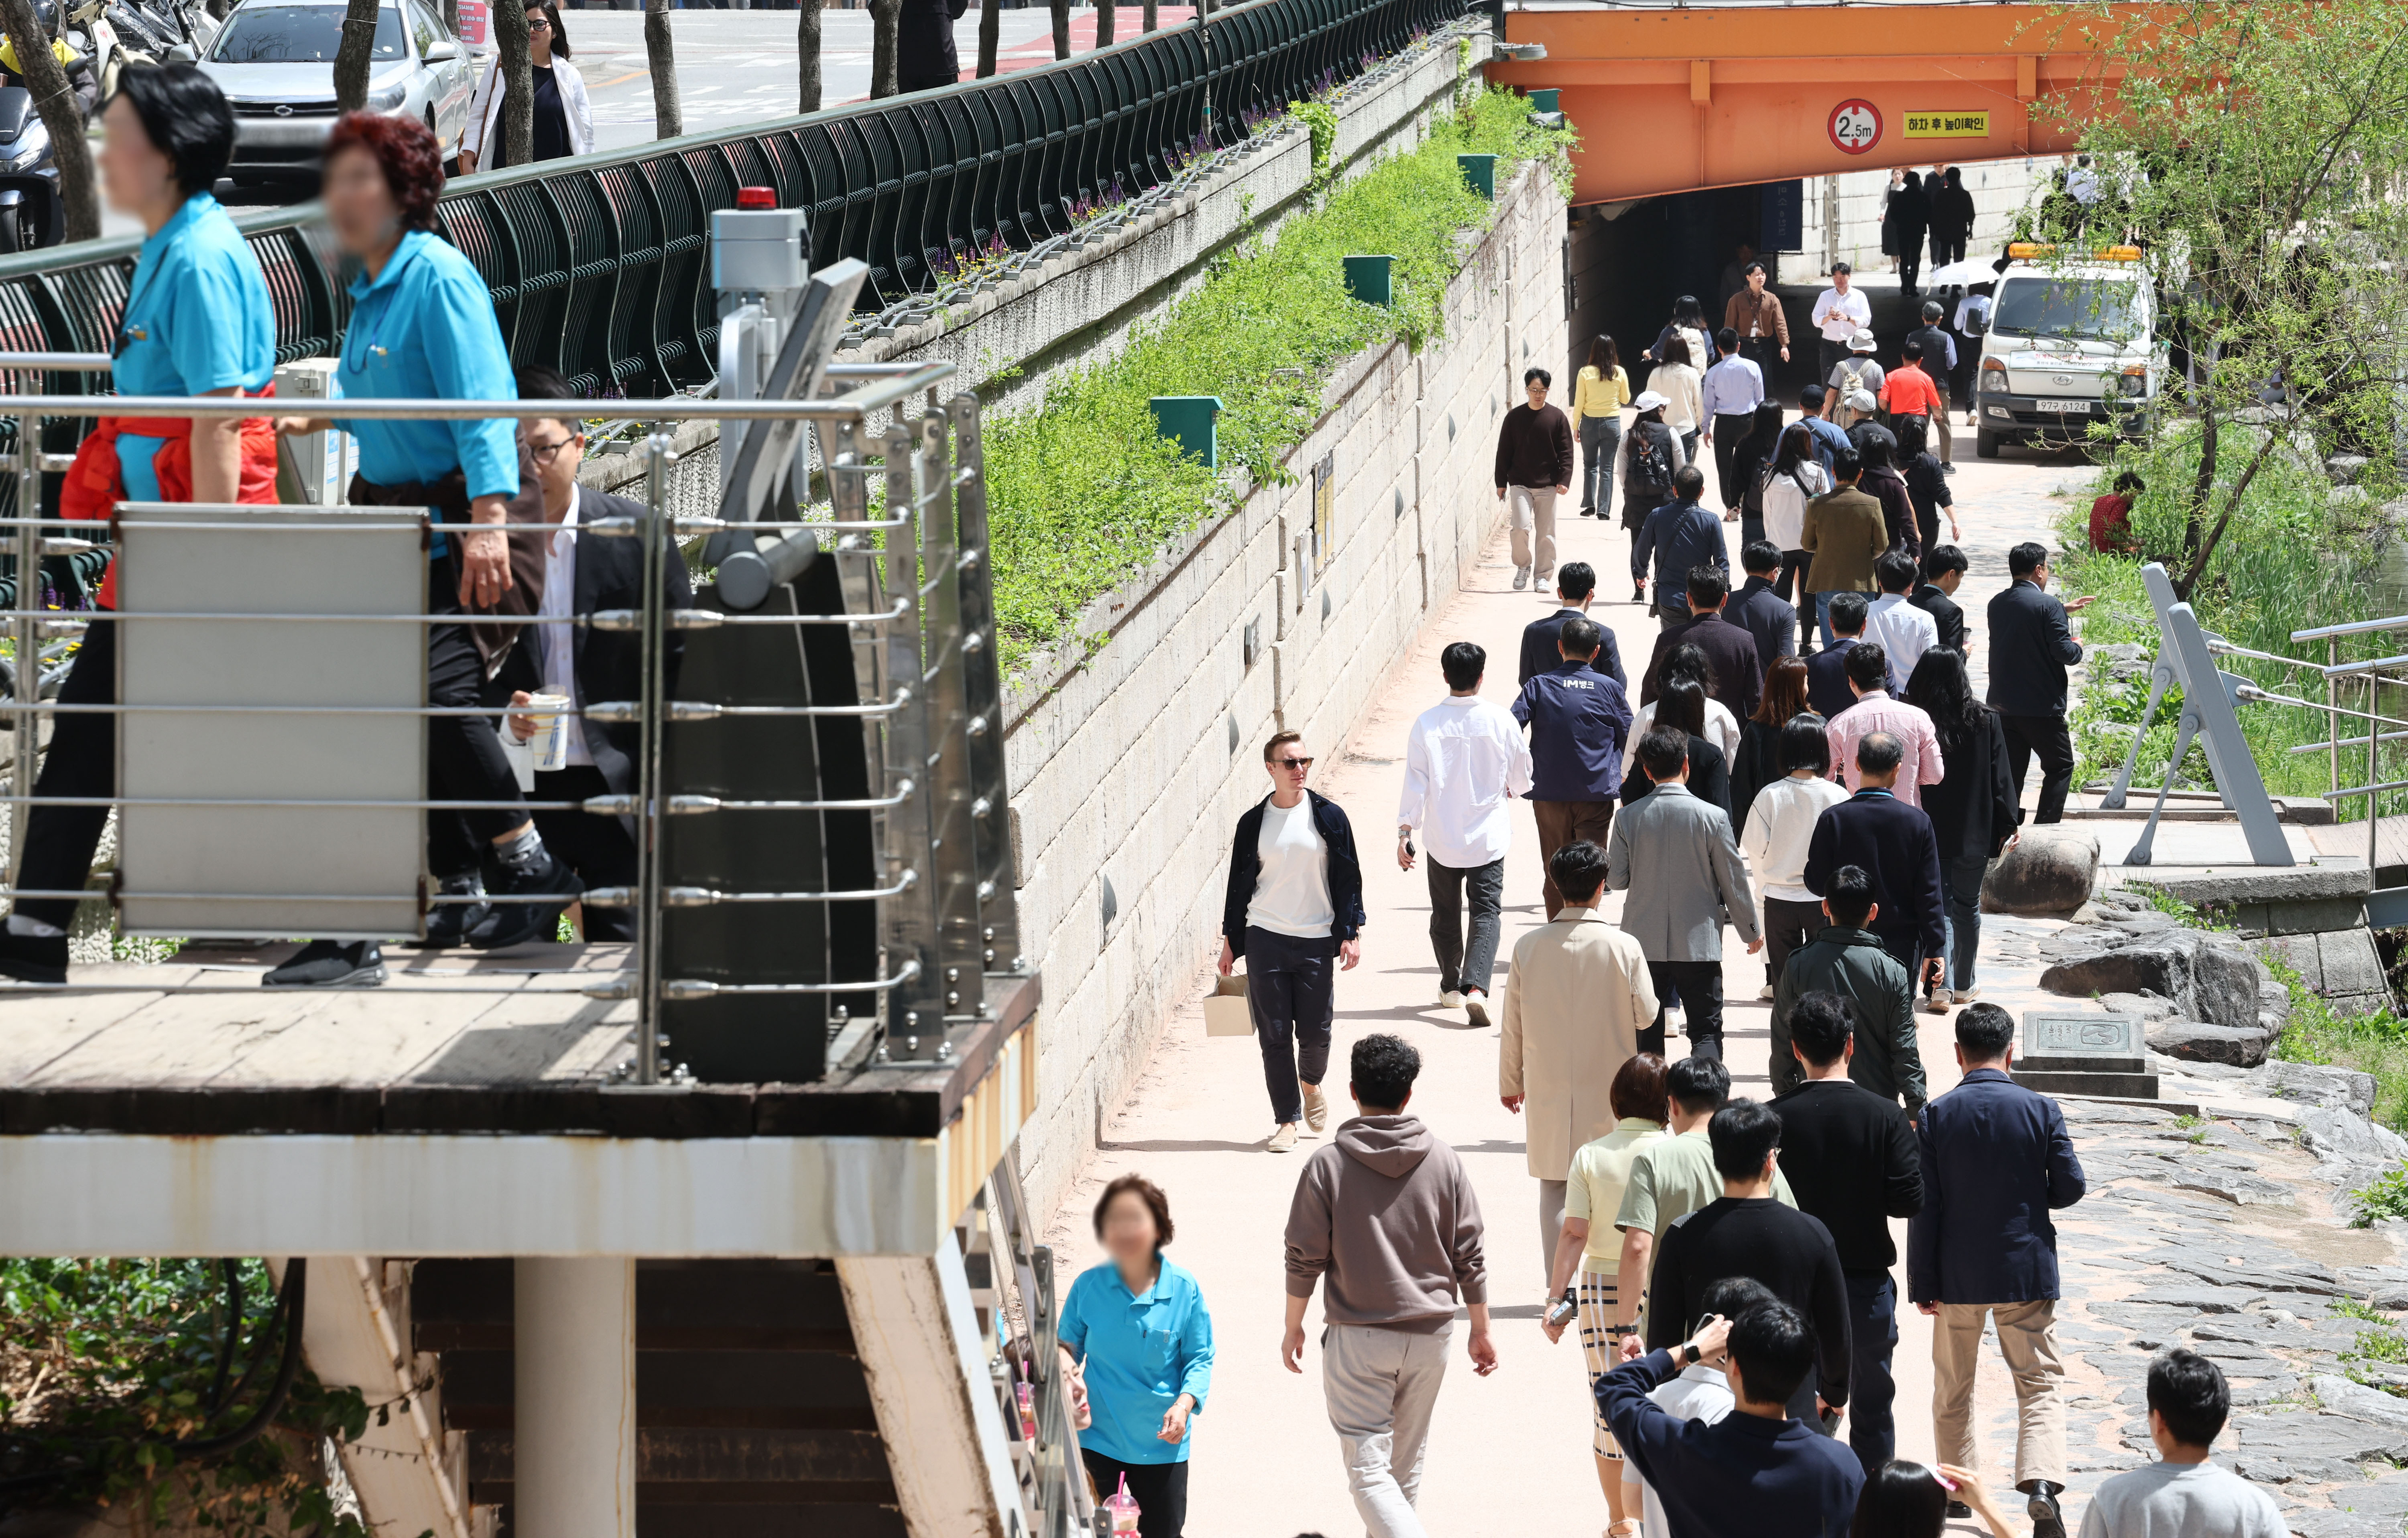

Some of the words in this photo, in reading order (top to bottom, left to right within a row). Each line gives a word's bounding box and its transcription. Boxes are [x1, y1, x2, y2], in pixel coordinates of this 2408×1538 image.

[1839, 116, 1871, 137] 2.5m
[1908, 118, 1929, 131] 하차
[1932, 117, 1941, 131] 후
[1944, 117, 1984, 131] 높이확인
[2041, 402, 2058, 410] 97구
[2062, 402, 2086, 411] 6124
[1563, 679, 1595, 689] iM뱅크
